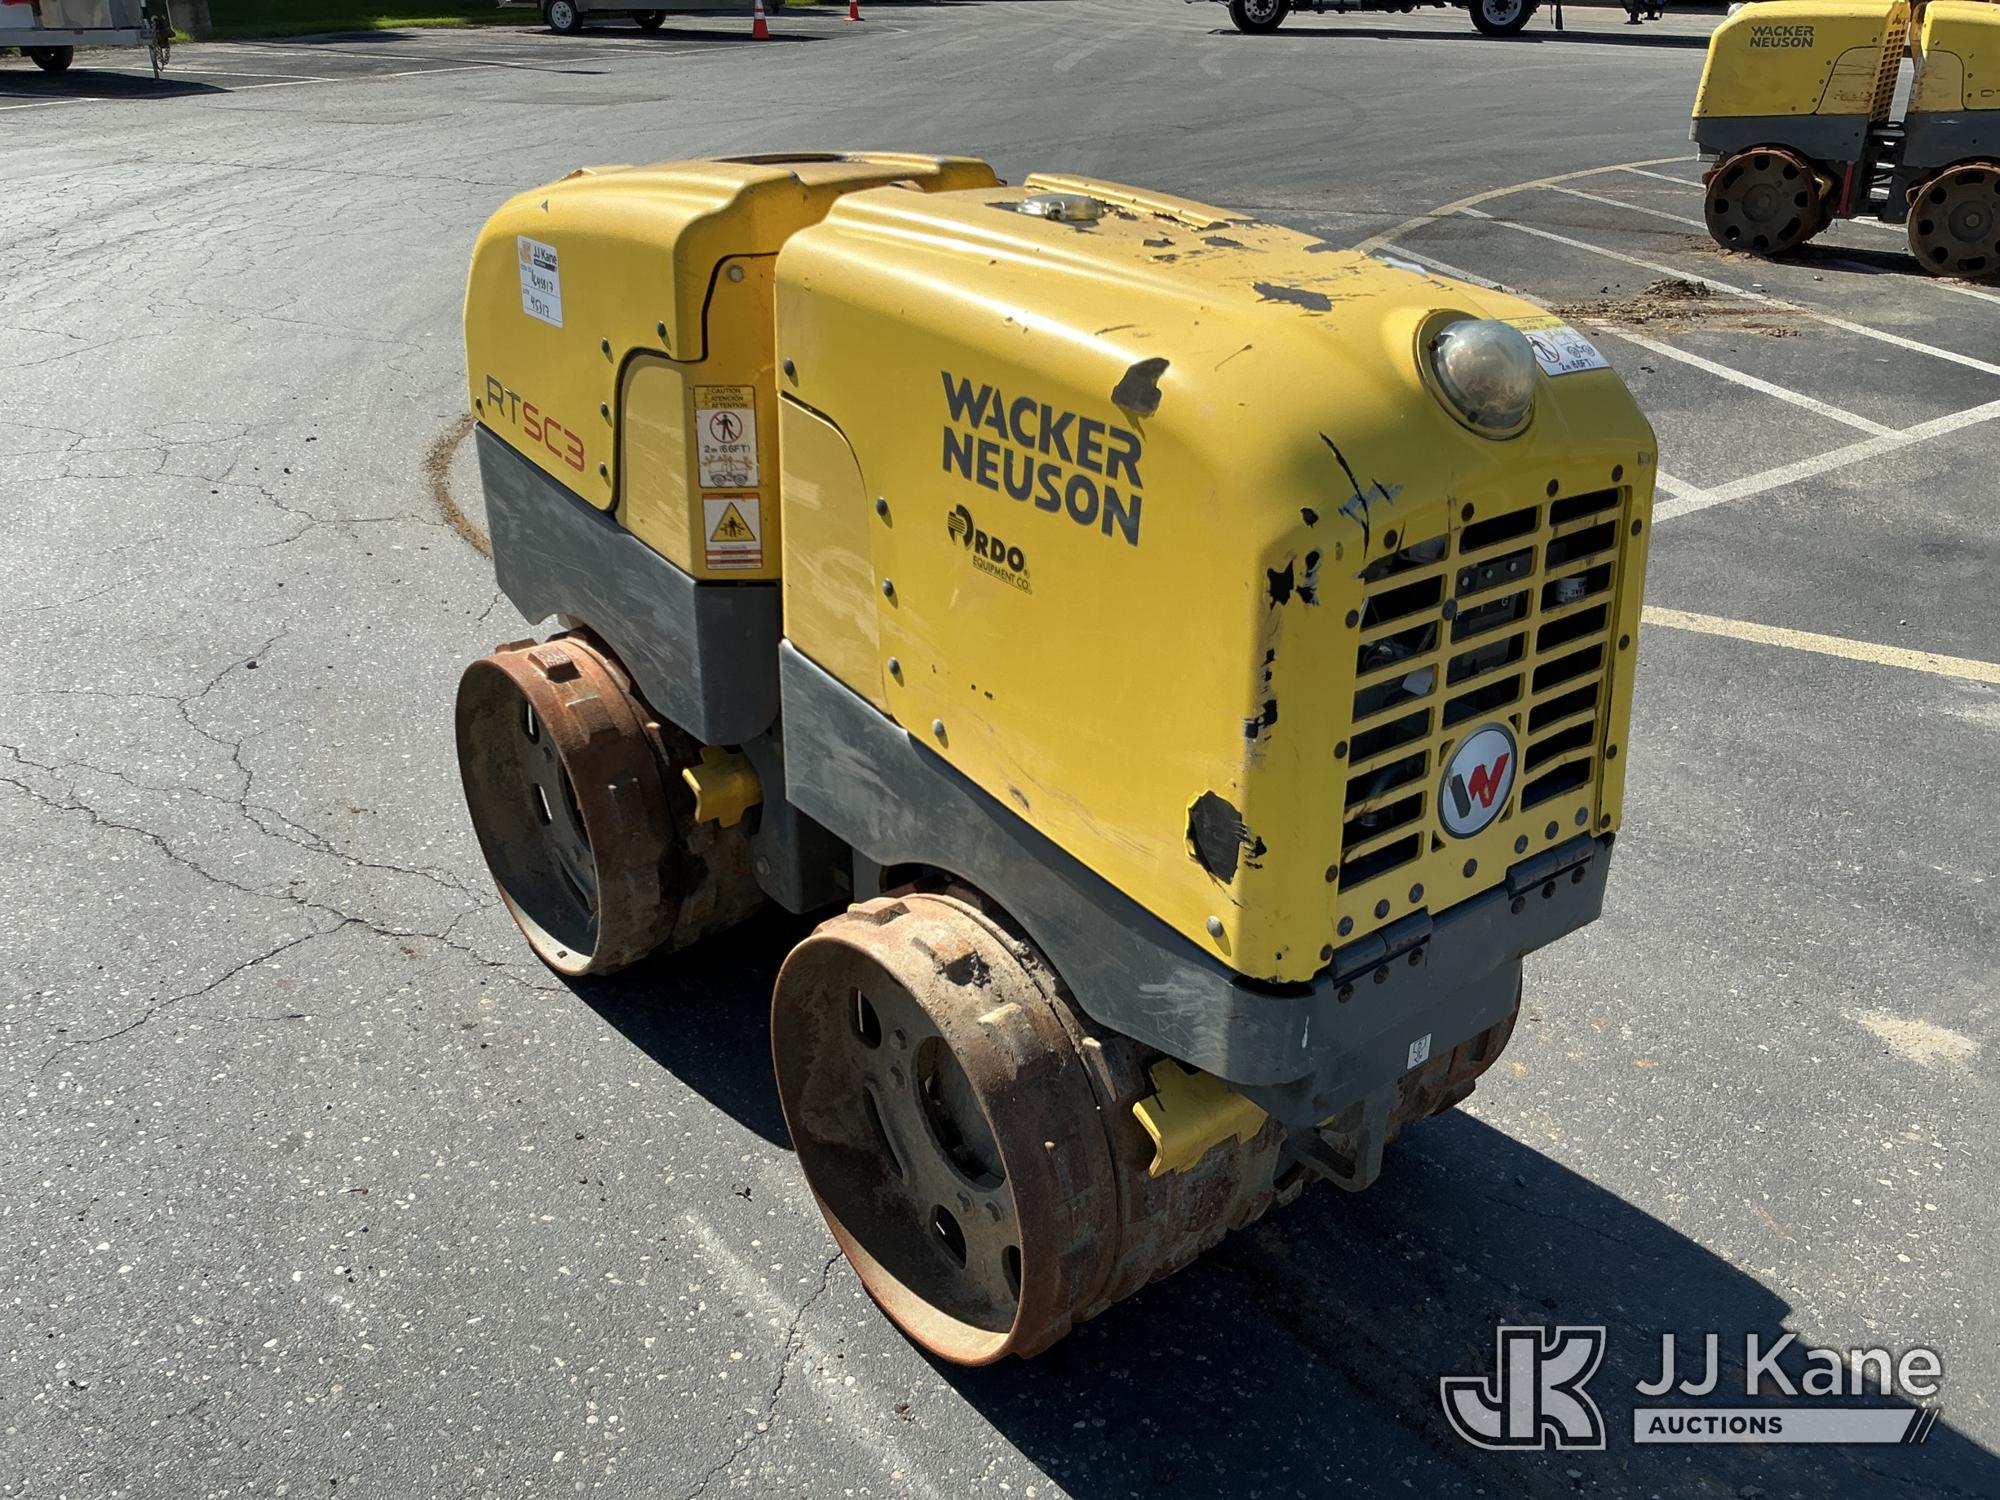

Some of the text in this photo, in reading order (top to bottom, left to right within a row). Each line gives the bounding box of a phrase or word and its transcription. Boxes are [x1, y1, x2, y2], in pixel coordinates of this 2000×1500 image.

[1749, 37, 1815, 48] NEUSON
[1751, 25, 1815, 37] WACKER
[541, 248, 557, 265] Kane
[486, 374, 585, 473] RTSC3
[940, 370, 1144, 490] WACKER
[942, 425, 1142, 547] NEUSON
[972, 555, 1016, 583] EQUIPMENT
